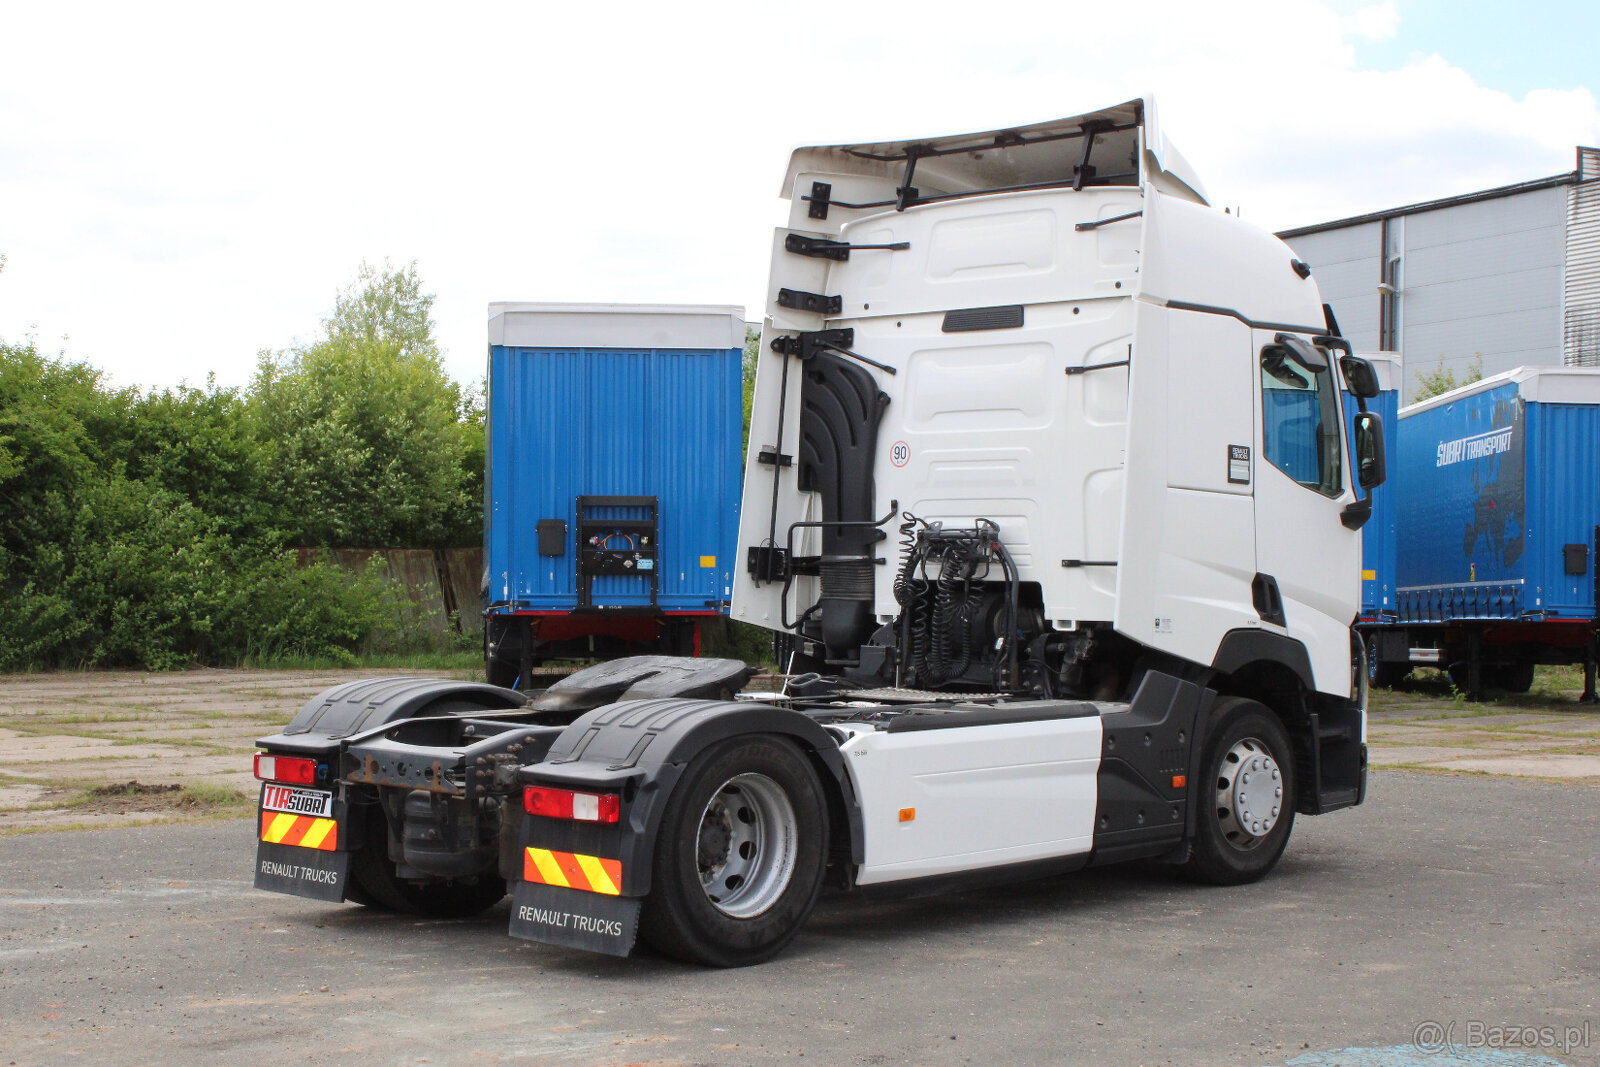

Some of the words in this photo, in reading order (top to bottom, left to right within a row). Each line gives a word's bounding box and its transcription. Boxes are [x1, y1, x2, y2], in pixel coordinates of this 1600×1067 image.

[894, 446, 907, 460] 90
[1467, 432, 1513, 460] TRANSPORT
[261, 860, 300, 879] RENAULT
[300, 866, 338, 885] TRUCKS
[518, 905, 571, 927] RENAULT
[572, 914, 623, 936] TRUCKS
